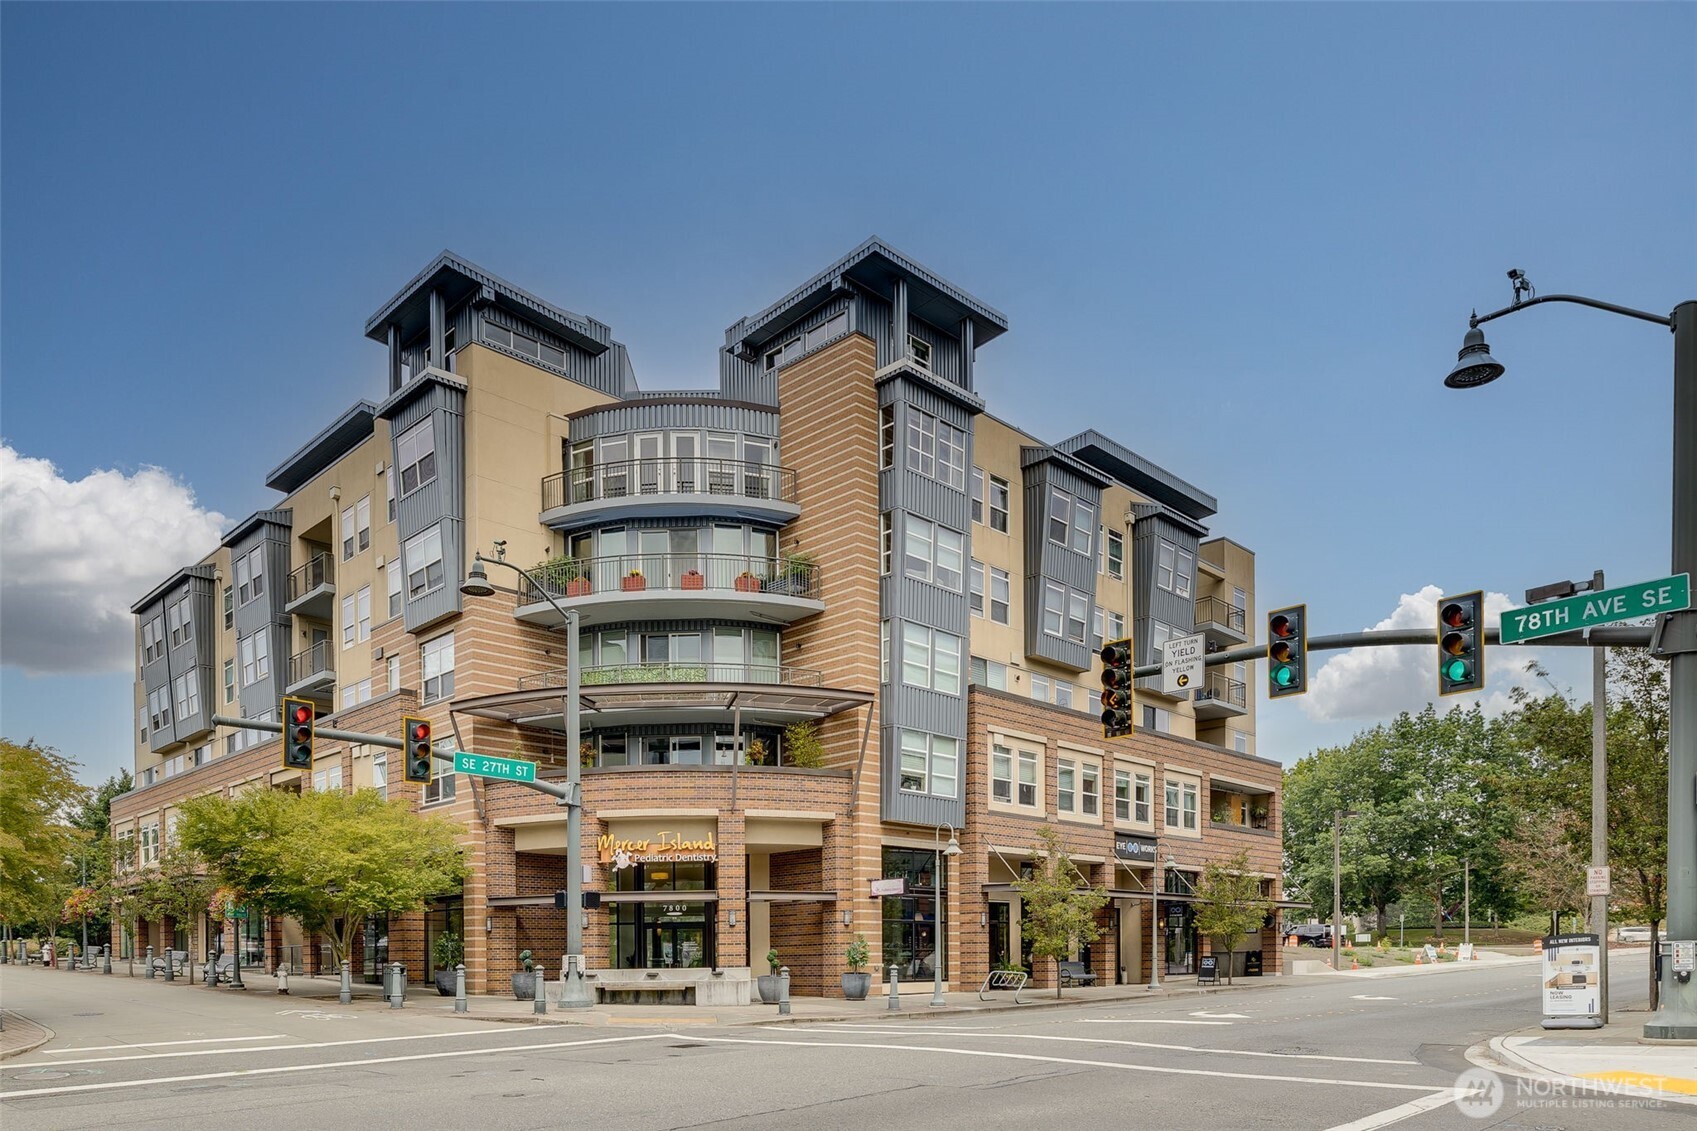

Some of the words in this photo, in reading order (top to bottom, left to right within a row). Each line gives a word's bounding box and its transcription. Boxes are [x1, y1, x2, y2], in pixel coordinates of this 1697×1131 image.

[1514, 606, 1569, 633] 78TH
[1582, 595, 1627, 620] AVE
[1642, 586, 1672, 608] SE
[1172, 646, 1196, 658] YIELD
[1174, 655, 1202, 666] FLASHING
[1172, 665, 1194, 674] YELLOW
[462, 757, 476, 770] SE
[482, 760, 510, 774] 27TH
[516, 766, 528, 776] ST
[597, 833, 650, 856] Mercer
[656, 831, 716, 852] Island
[1116, 842, 1126, 850] EYE
[634, 853, 674, 863] Pediatric
